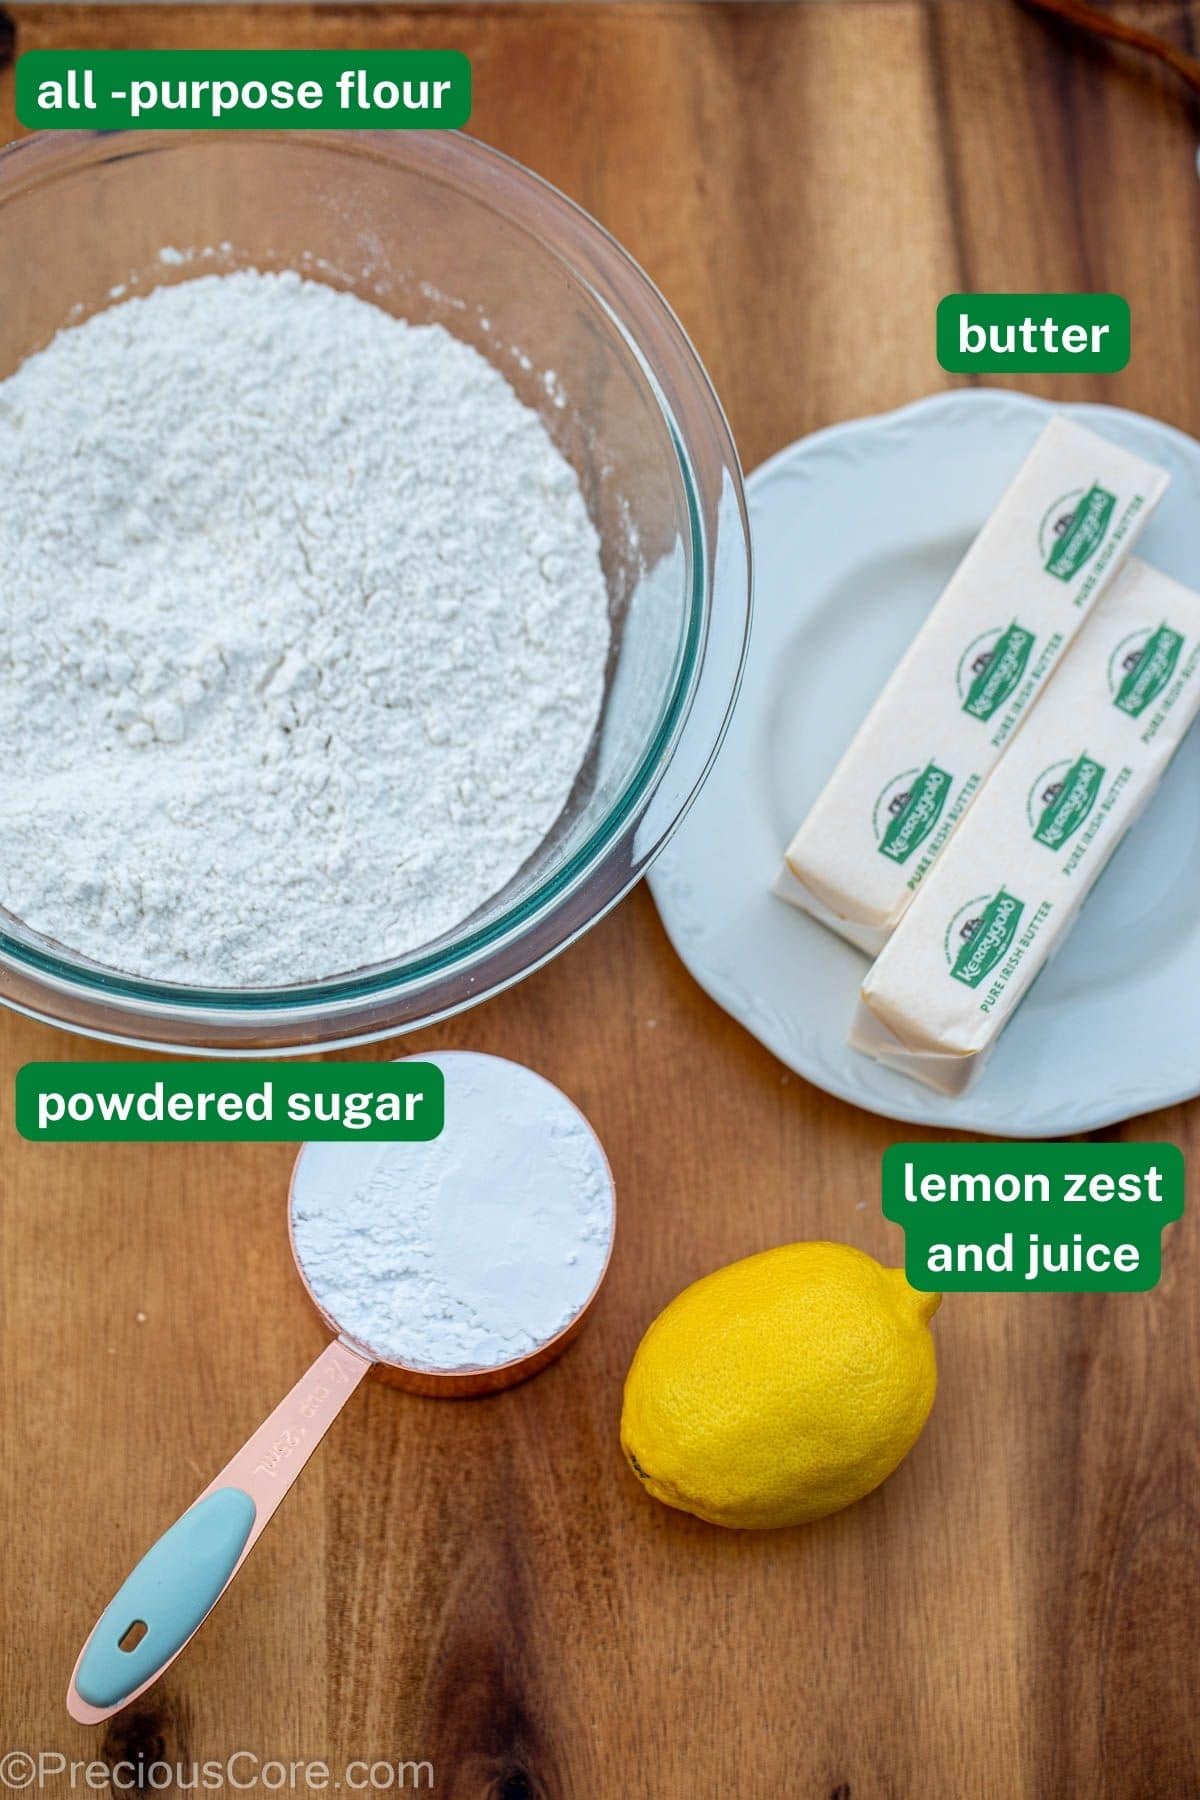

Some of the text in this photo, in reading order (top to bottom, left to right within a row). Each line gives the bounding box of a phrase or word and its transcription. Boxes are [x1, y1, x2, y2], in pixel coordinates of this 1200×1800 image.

[907, 773, 981, 890] PURE IRISH BUTTER
[980, 901, 1054, 1013] PURE IRISH BUTTER
